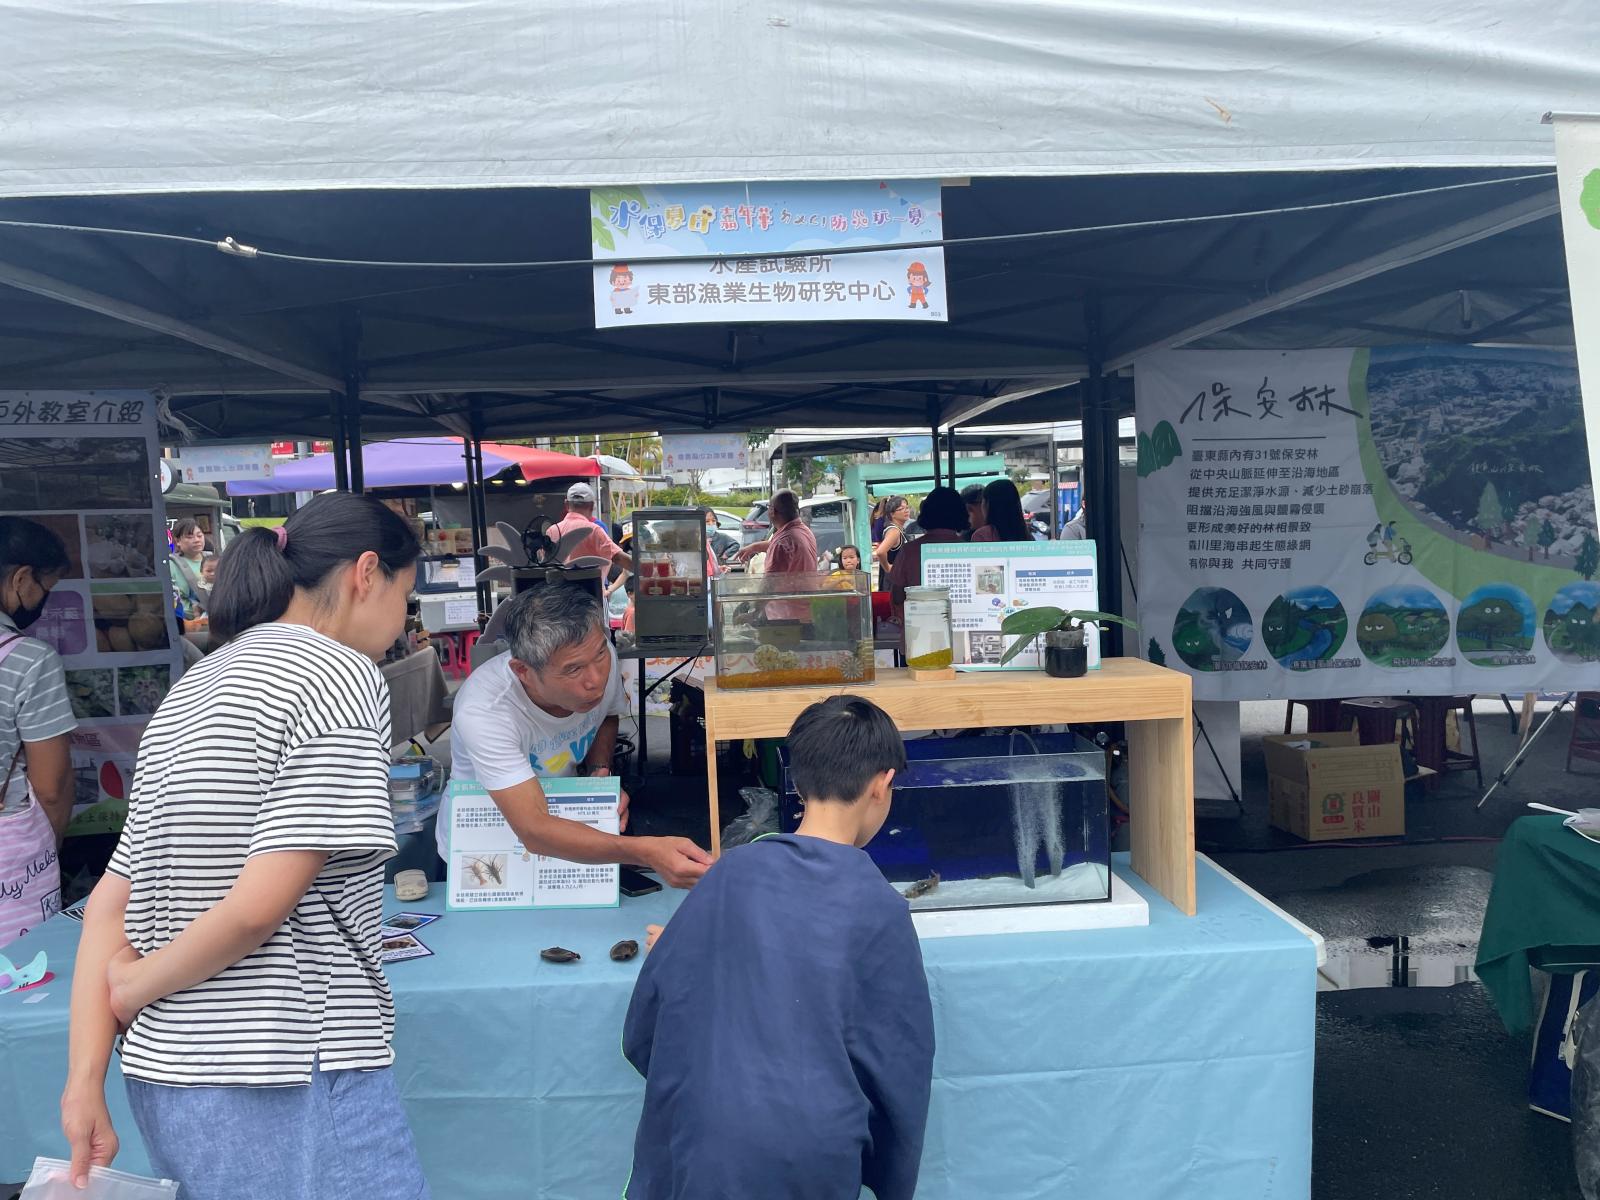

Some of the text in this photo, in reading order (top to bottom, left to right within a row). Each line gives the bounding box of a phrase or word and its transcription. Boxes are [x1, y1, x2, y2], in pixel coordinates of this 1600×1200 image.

[709, 253, 832, 274] 水產試驗所
[647, 279, 896, 306] 東部漁業生物研究中心
[1179, 376, 1364, 425] 保安林
[1191, 447, 1319, 462] 臺東縣內有31號保安林
[1189, 465, 1340, 480] 從中央山脈延伸至沿海地區
[1187, 483, 1375, 498] 提供充足潔淨水源、減少土砂崩落
[1186, 521, 1312, 534] 更形成美好的林相景致
[1188, 557, 1292, 570] 有你與我 共同守護
